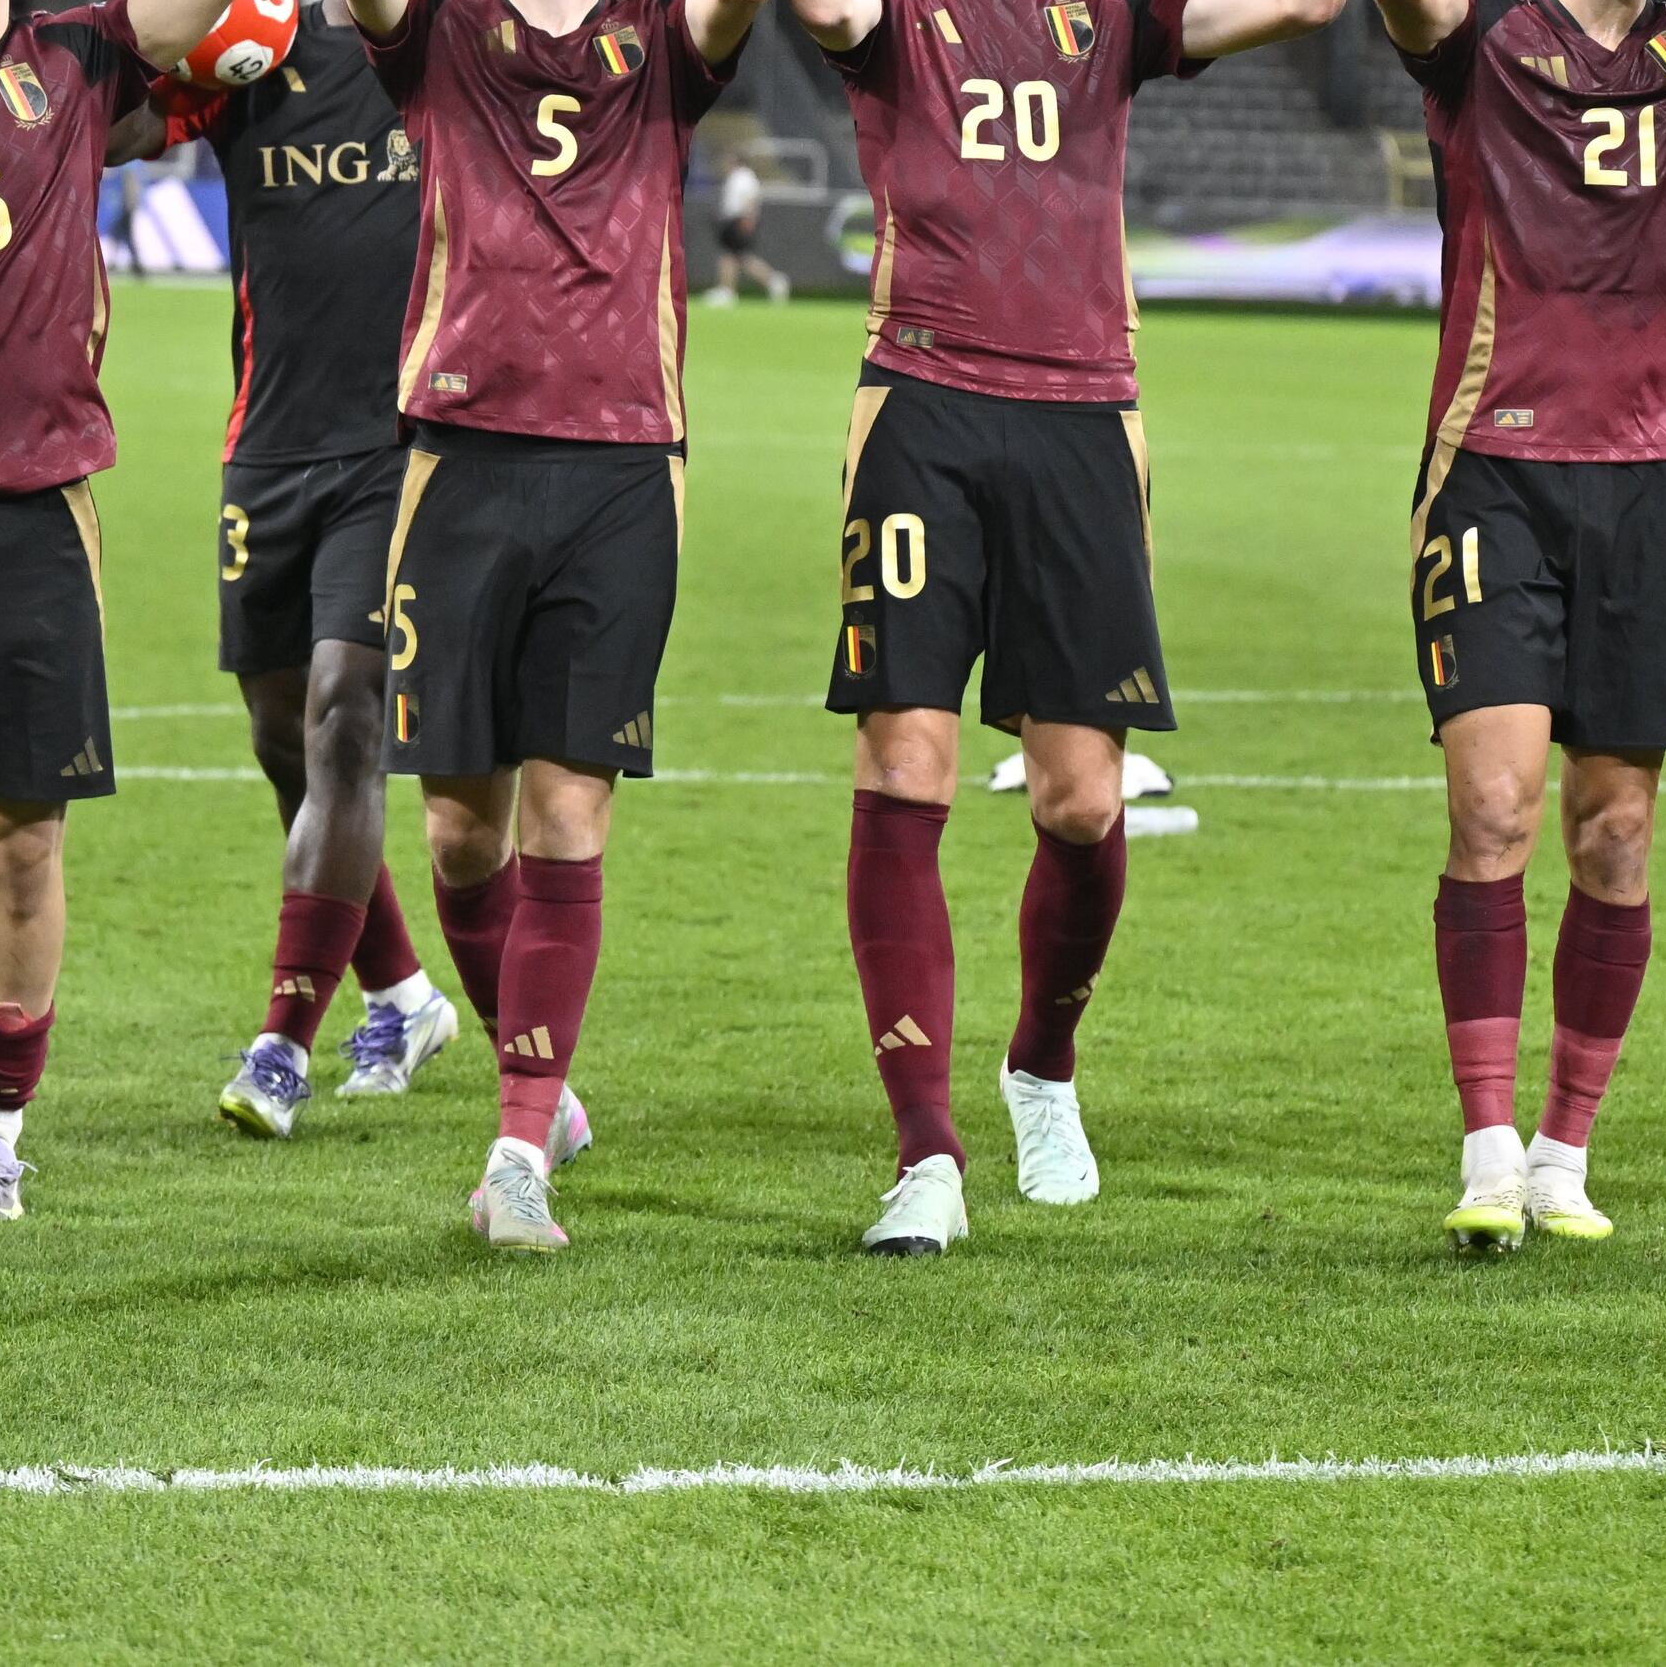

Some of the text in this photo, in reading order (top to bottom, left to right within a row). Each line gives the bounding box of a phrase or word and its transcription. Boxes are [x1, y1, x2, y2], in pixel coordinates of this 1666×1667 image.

[229, 56, 263, 80] 42
[531, 94, 580, 176] 5
[961, 79, 1059, 161] 20
[1582, 105, 1656, 186] 21
[259, 141, 369, 188] ING
[841, 513, 926, 605] 20
[1423, 527, 1483, 621] 21
